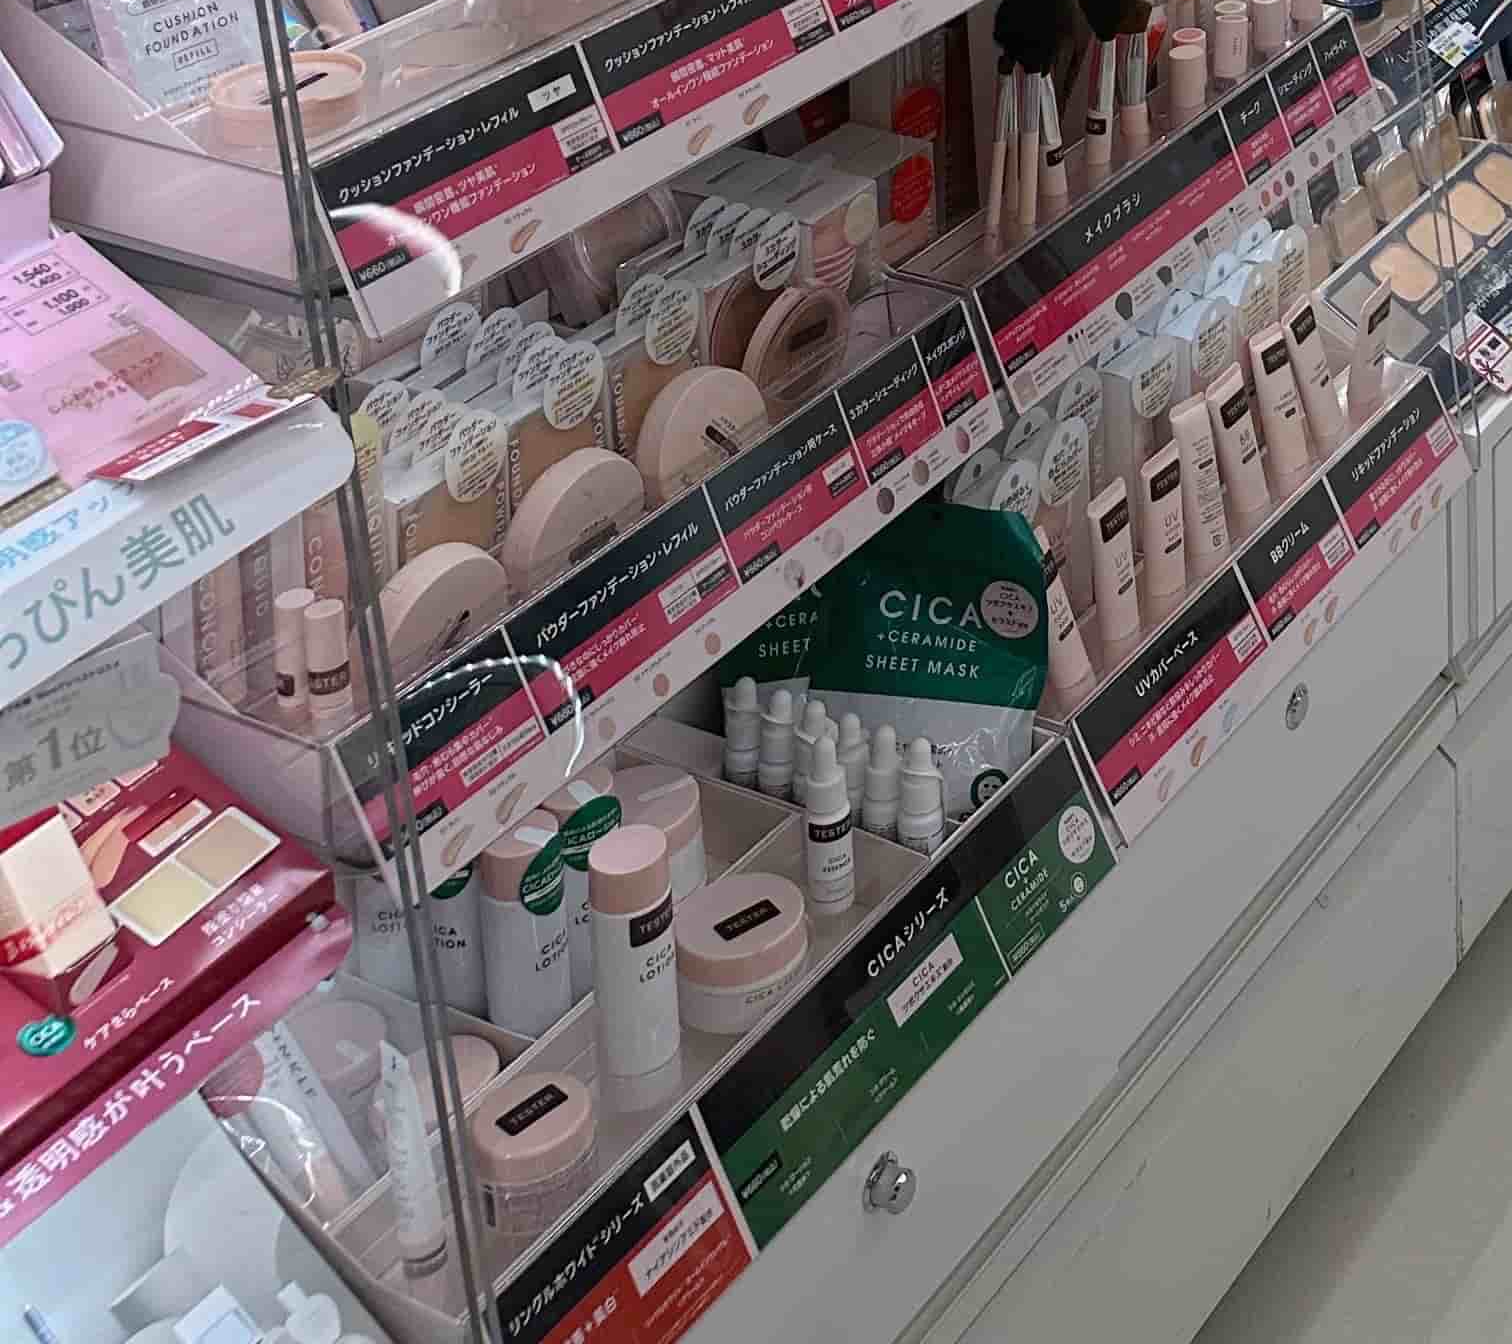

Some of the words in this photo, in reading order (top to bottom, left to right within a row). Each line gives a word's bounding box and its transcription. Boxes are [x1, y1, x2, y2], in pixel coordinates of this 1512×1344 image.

[143, 10, 241, 58] FOUNDATION
[151, 0, 221, 34] CUSHION
[1238, 100, 1262, 124] チーク
[337, 105, 520, 204] クッションファンデーション・レフィル
[1083, 190, 1146, 245] メイクブラシ
[722, 423, 840, 512] パウダーファンデーション用ケース
[1268, 522, 1311, 565] BBクリーム
[0, 492, 236, 671] っぴん美肌
[535, 520, 700, 649] パウダーファンデーション・レフィル
[879, 589, 984, 630] CICA
[757, 637, 813, 658] SHEET
[864, 653, 921, 674] SHEET
[927, 659, 981, 680] MASK
[1133, 629, 1200, 699] UVカバーベース
[1003, 847, 1041, 891] CICA
[865, 885, 951, 980] CICAシリーズ
[911, 960, 937, 988] CICA
[507, 1190, 645, 1336] リンクルホワイトシリーズ
